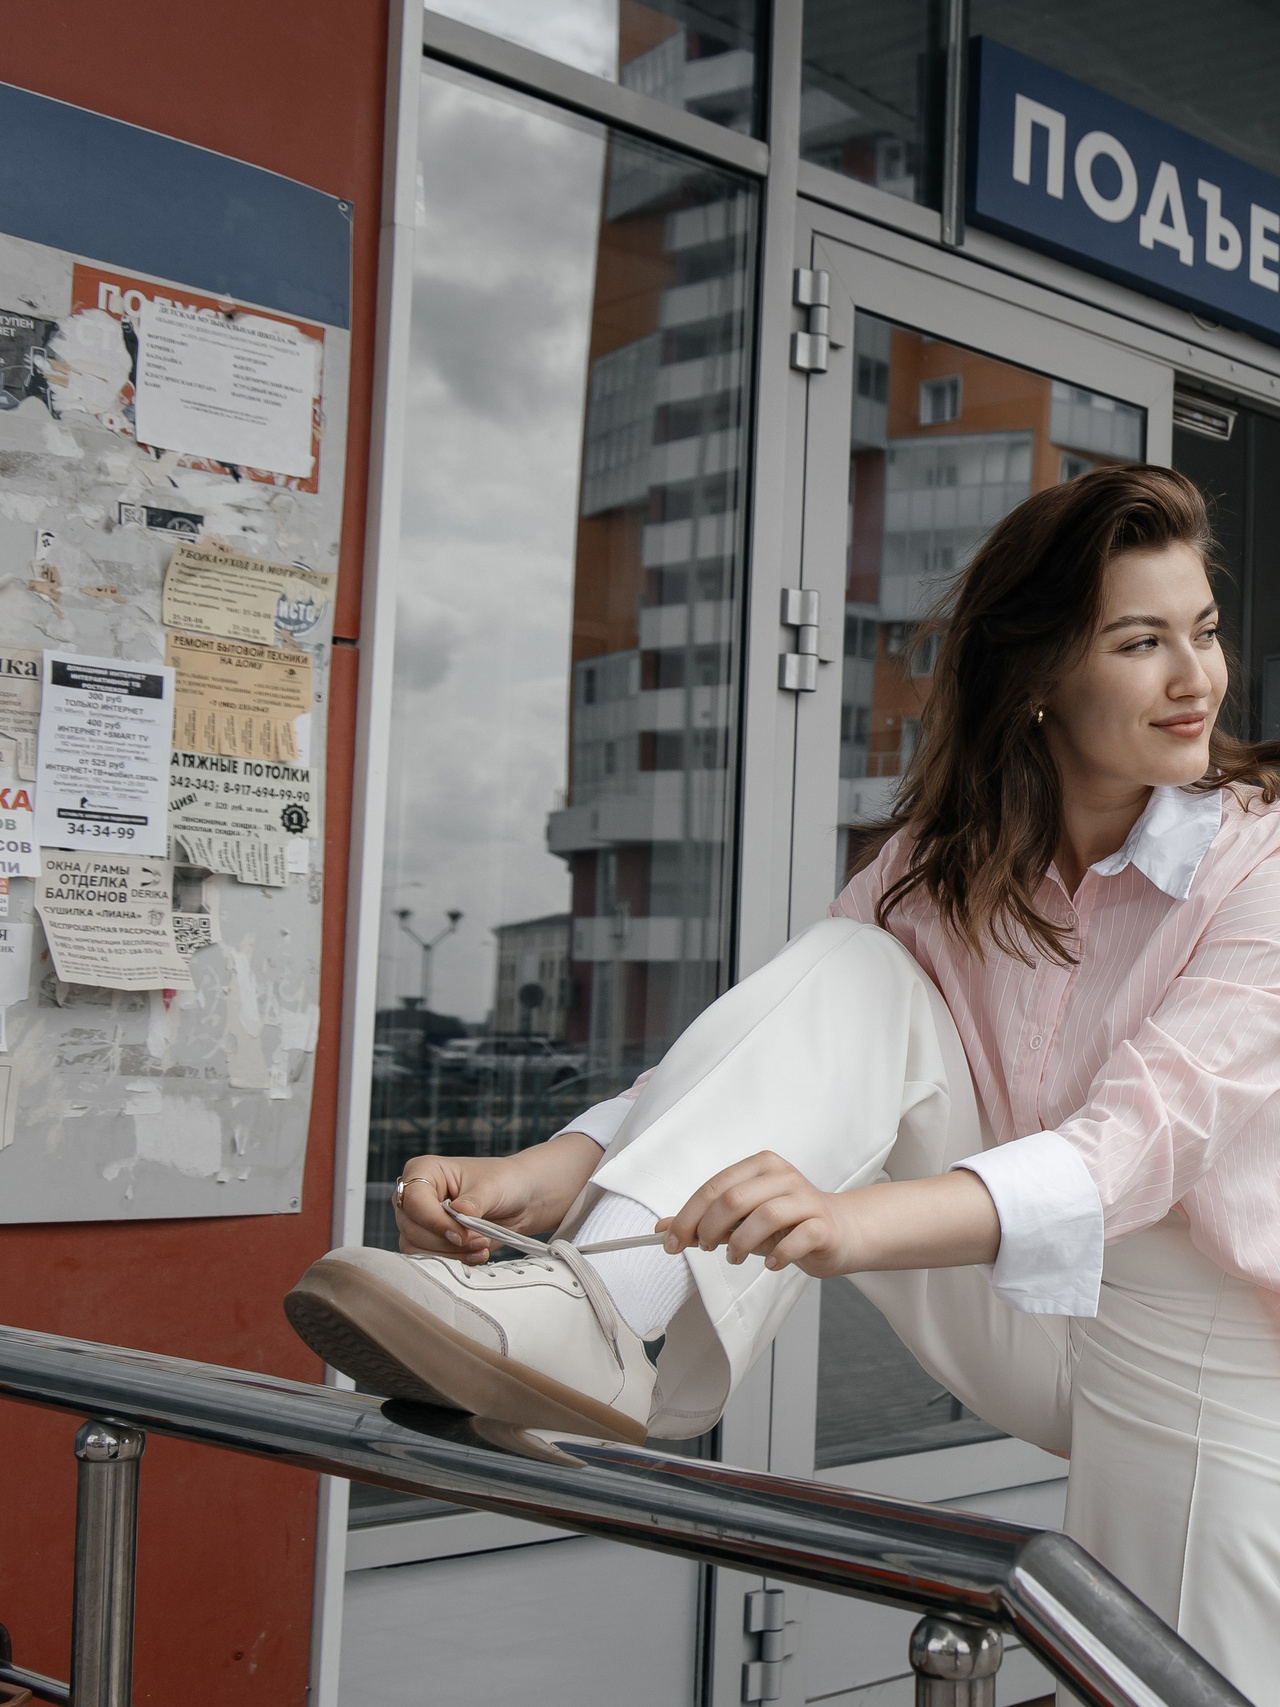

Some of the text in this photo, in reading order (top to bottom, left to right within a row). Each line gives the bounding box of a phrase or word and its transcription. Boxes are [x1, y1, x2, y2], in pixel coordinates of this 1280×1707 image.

[173, 635, 214, 649] РЕМОНТ
[217, 642, 265, 657] БЫТОВОЙ
[267, 650, 309, 665] ТЕХНИКИ
[0, 658, 38, 677] ка
[235, 659, 264, 670] ДОМУ
[87, 692, 122, 704] 300 руб
[64, 698, 144, 715] ТОЛЬКО ИНТЕРНЕТ
[86, 718, 121, 730] 400 руб
[57, 724, 101, 737] ИНТЕРНЕТ
[138, 734, 150, 742] TV
[108, 761, 125, 770] руб
[170, 752, 310, 783] АТЯЖНЫЕ ПОТОЛКИ
[223, 782, 310, 802] 8-917-694-99-90
[167, 792, 198, 813] ЦИЯ!
[66, 822, 136, 839] 34-34-99
[46, 860, 82, 872] ОКНА
[93, 864, 130, 875] РАМЫ
[59, 873, 128, 889] ОТДЕЛКА
[45, 887, 128, 903] БАЛКОНОВ
[130, 888, 169, 899] DERIKA
[43, 906, 143, 920] СУШИЛКА «ЛИАНА»
[49, 920, 168, 937] БЕСПРОЦЕНТНАЯ РАССРОЧКА
